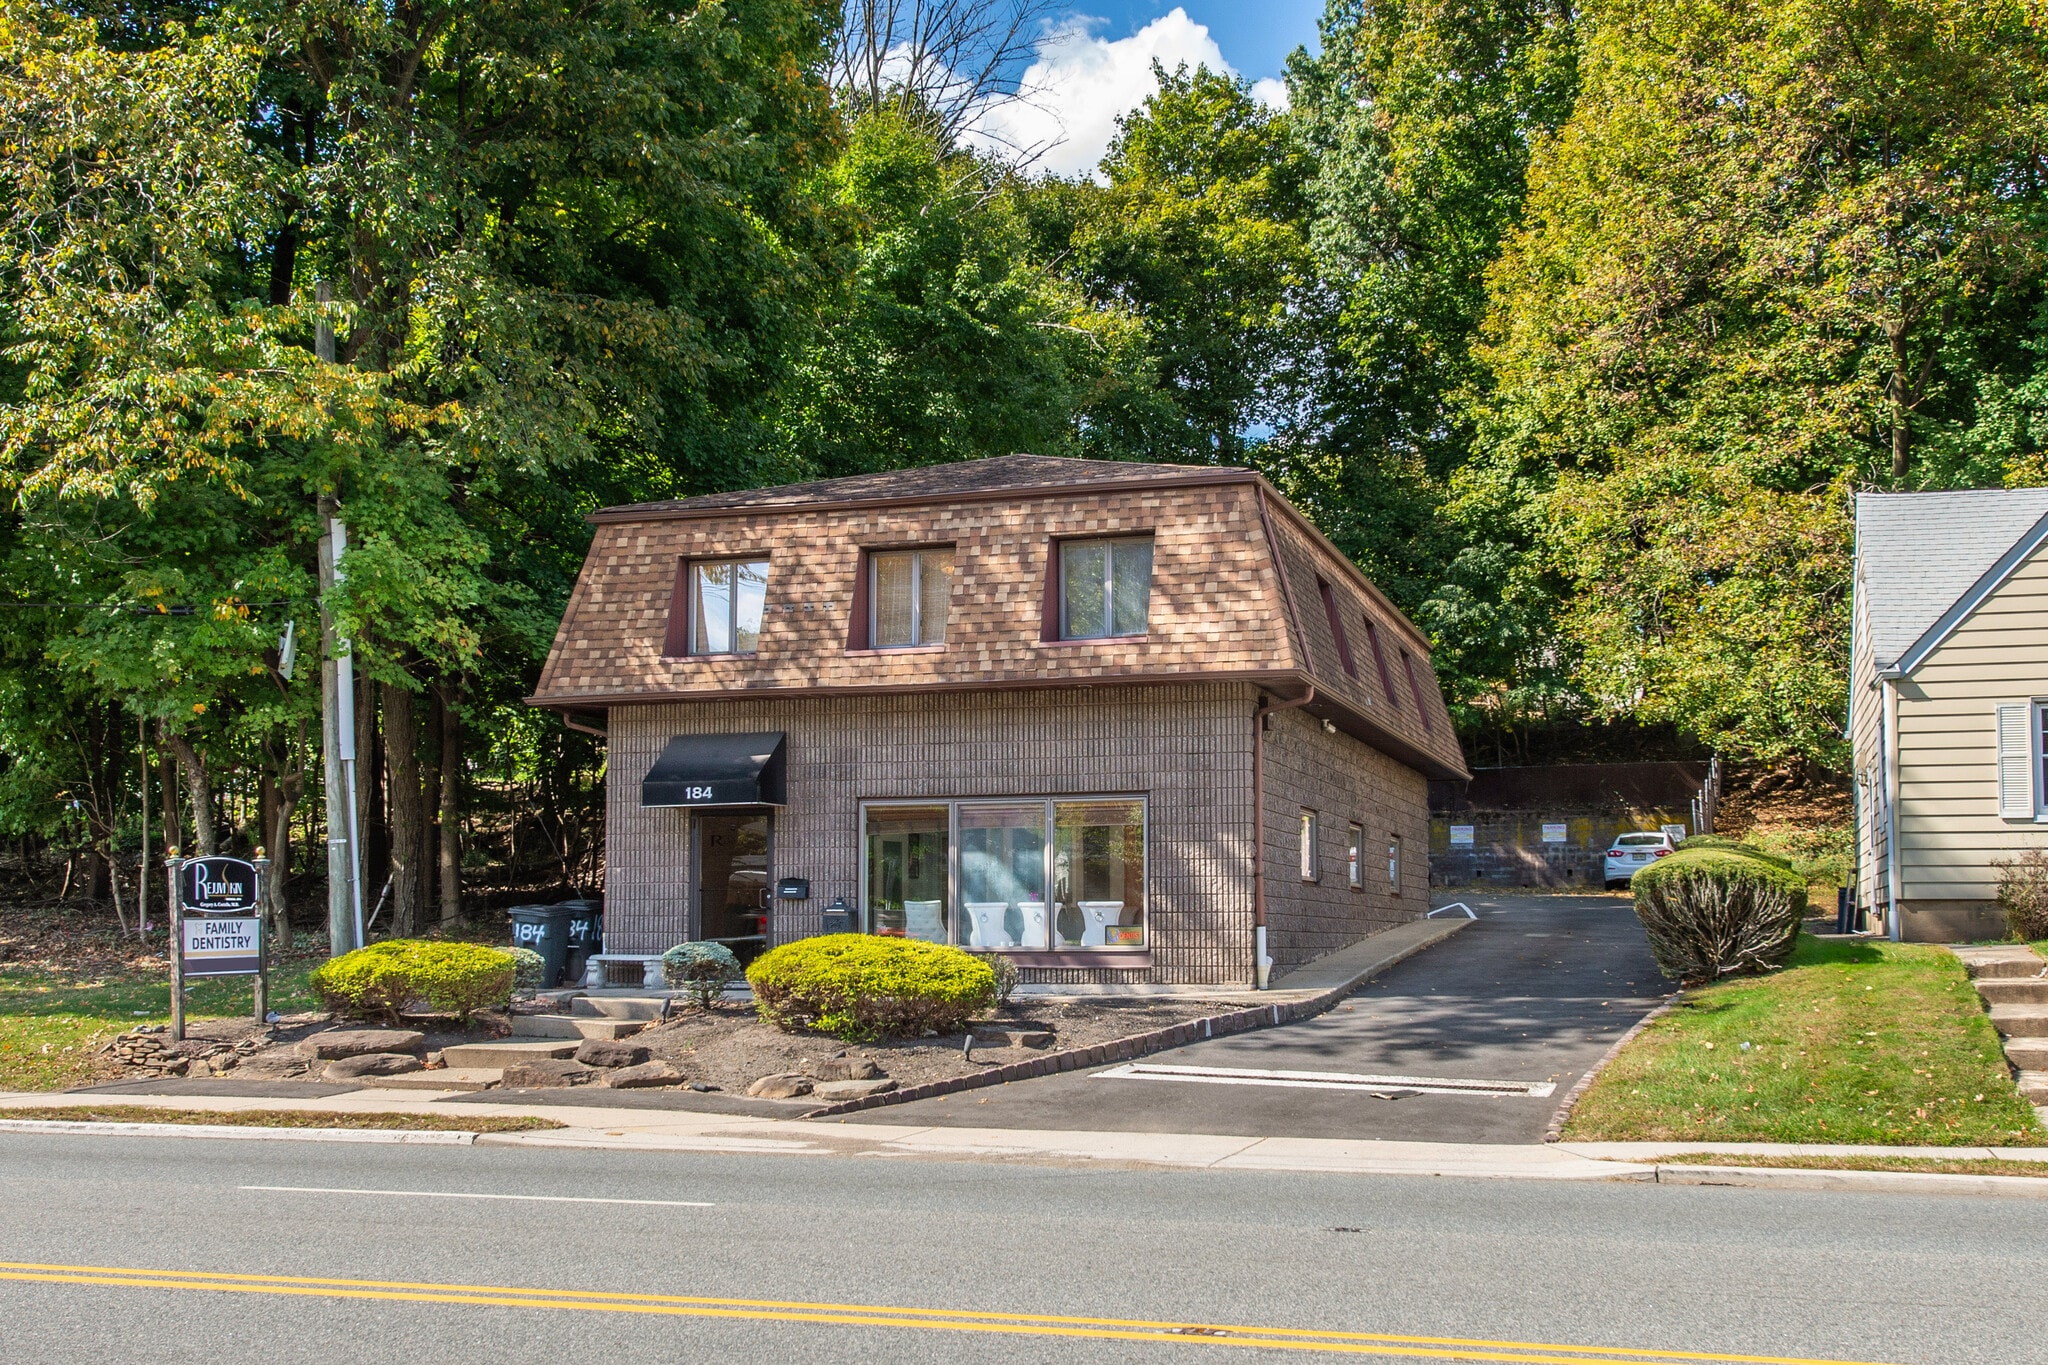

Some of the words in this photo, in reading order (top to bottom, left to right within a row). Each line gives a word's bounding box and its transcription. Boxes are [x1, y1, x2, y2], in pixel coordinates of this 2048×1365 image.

[685, 786, 713, 799] 184
[206, 922, 242, 934] FAMILY
[515, 924, 545, 945] 184
[192, 936, 251, 950] DENTISTRY
